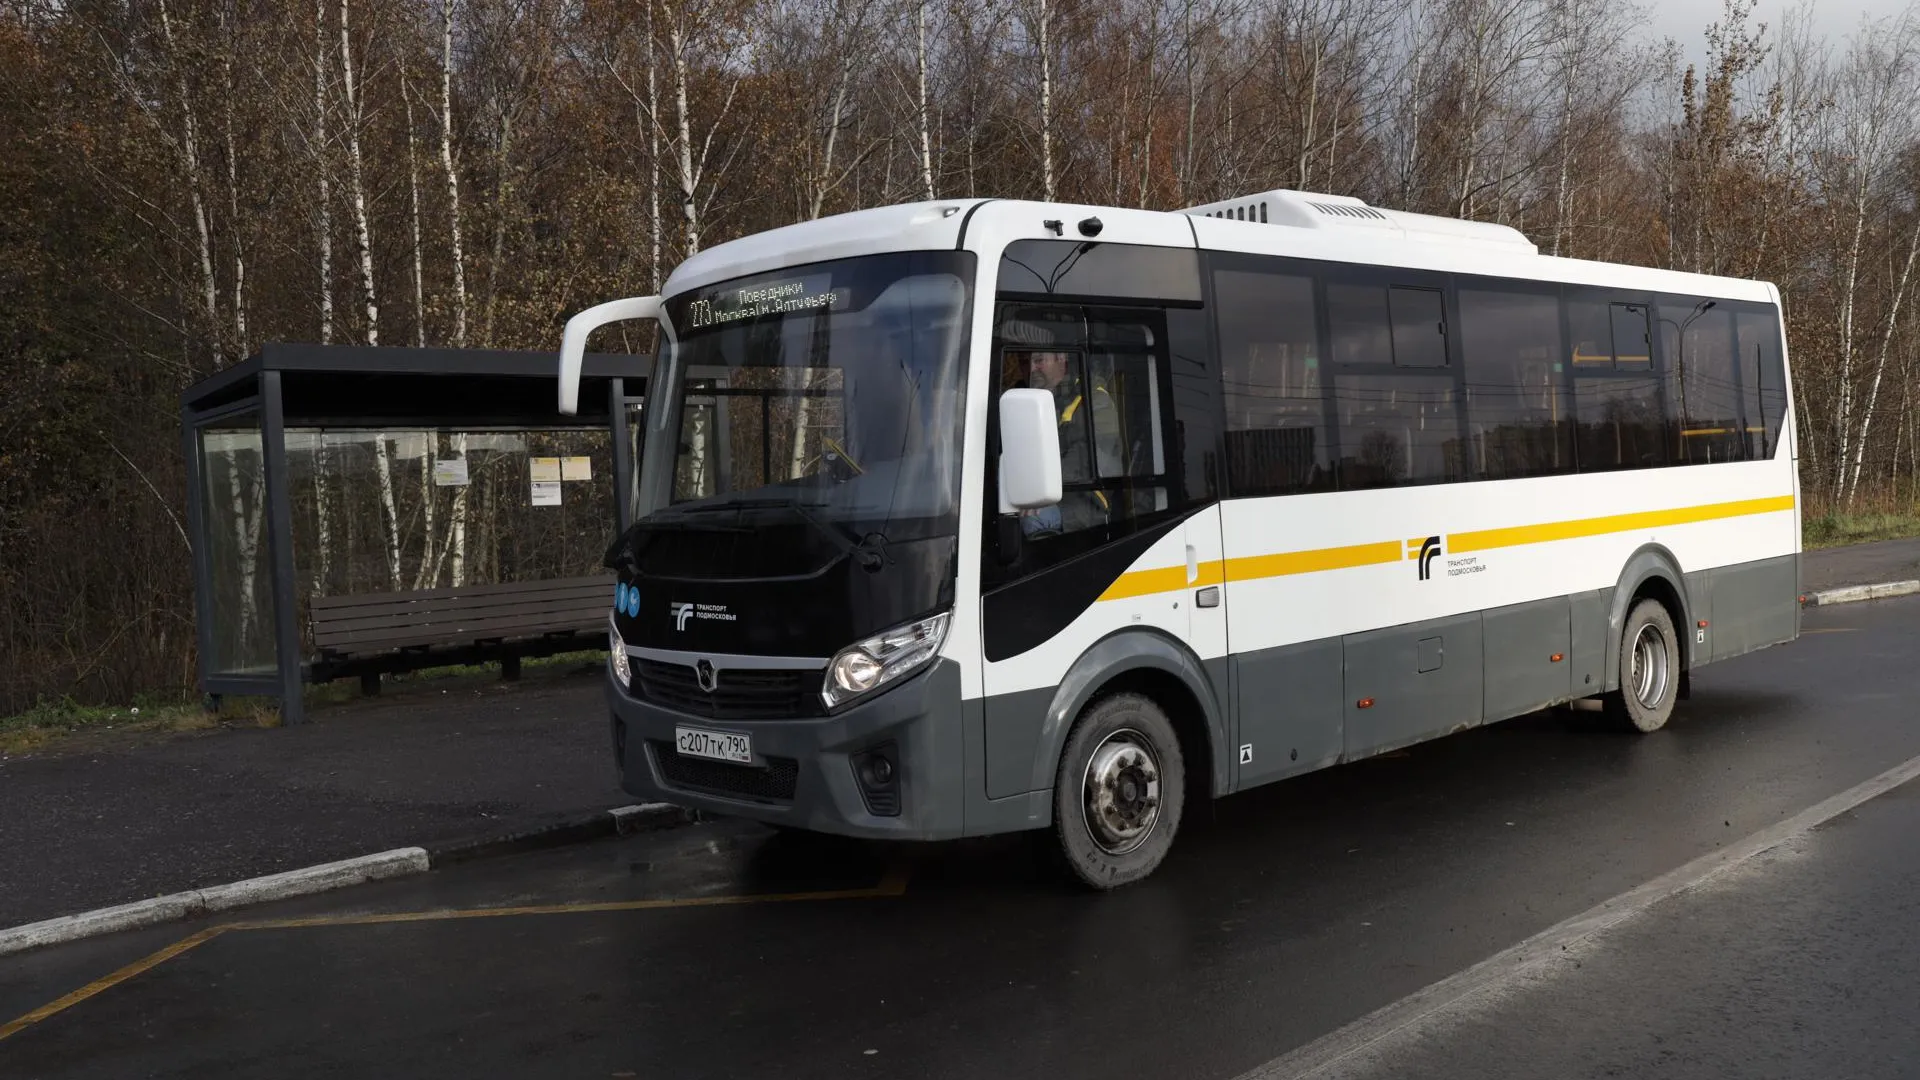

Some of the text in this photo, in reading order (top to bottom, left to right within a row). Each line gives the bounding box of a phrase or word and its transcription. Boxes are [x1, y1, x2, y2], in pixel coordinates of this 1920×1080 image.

[739, 282, 803, 305] Поведники
[690, 299, 712, 328] 273
[1447, 556, 1477, 568] ТРАНСПОРТ
[1447, 564, 1487, 577] ПОДМОСКОВЬЯ
[696, 603, 727, 612] ТРАНСПОРТ
[696, 611, 737, 621] ПОДМОСКОВЬЯ
[726, 736, 746, 753] 790
